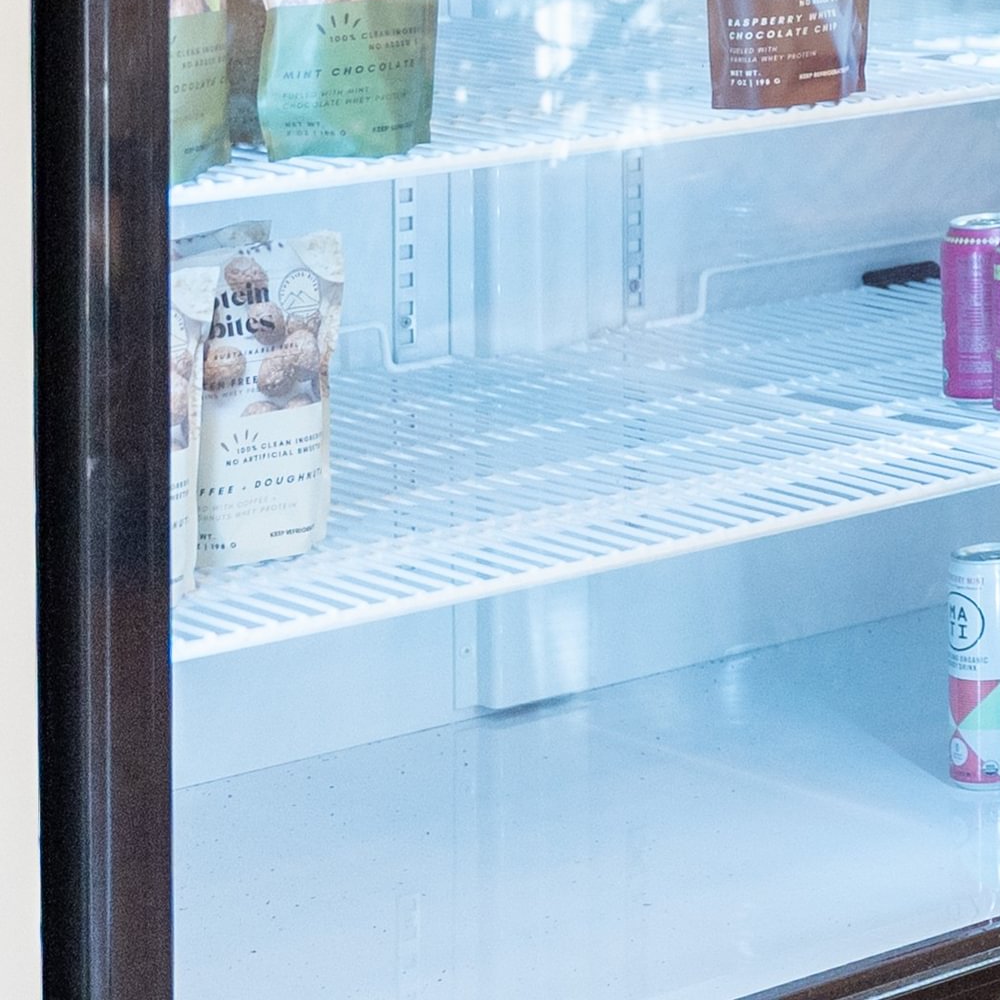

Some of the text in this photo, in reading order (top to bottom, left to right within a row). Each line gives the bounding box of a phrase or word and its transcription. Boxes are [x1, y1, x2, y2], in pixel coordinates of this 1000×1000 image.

[727, 8, 836, 27] RASPBERRY WHITE
[729, 22, 837, 40] CHOCOLATE CHIP
[283, 58, 416, 80] MINT CHOCOLATE
[261, 439, 292, 450] CLEAN
[225, 458, 239, 468] NO
